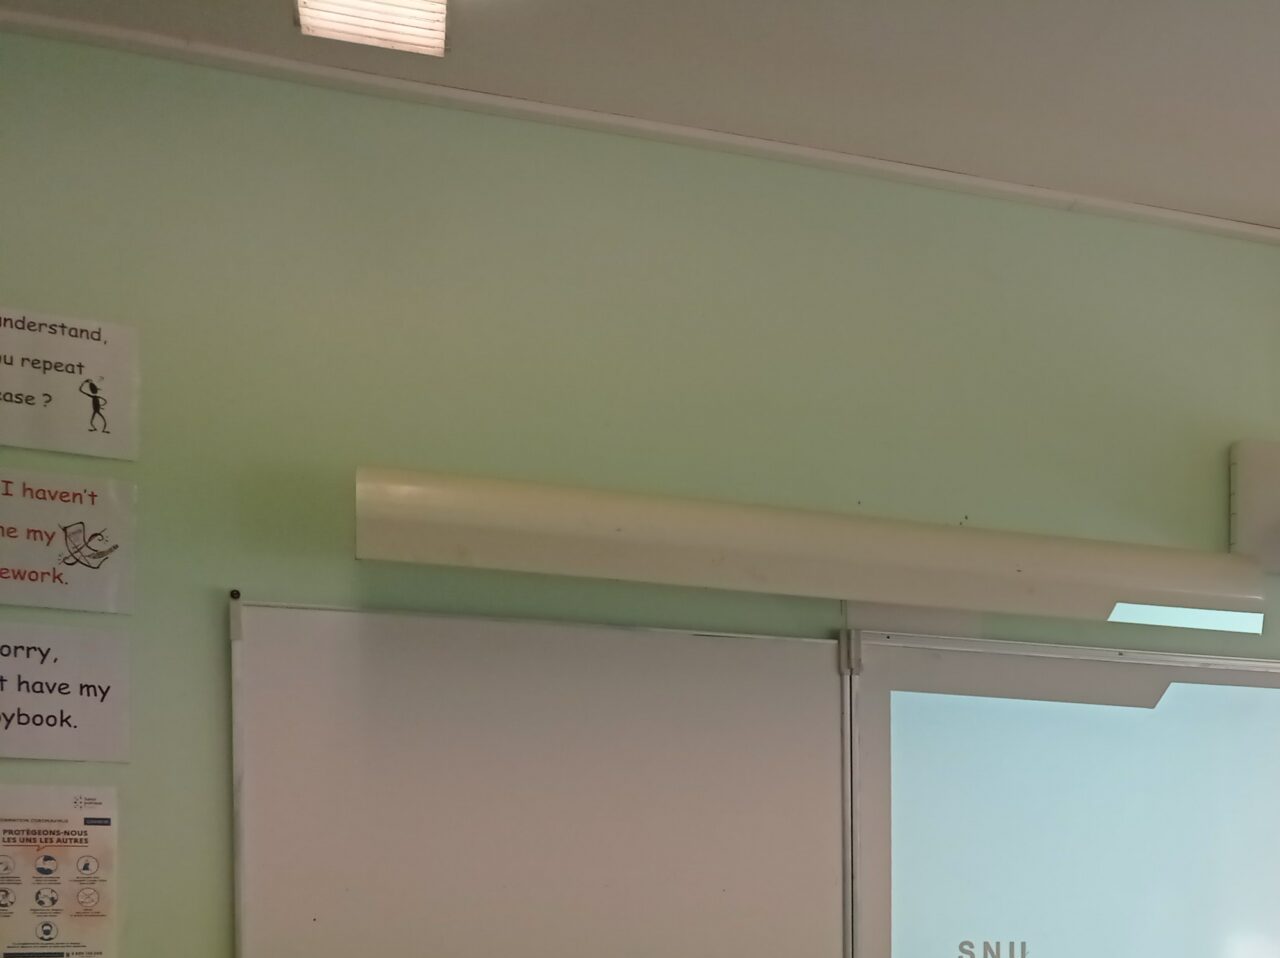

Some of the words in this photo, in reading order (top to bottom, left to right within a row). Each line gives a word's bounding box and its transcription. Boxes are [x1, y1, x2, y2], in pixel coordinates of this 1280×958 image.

[0, 316, 107, 345] nderstand,
[21, 357, 85, 375] repeat
[0, 392, 36, 406] ase
[1, 480, 14, 497] I
[22, 482, 98, 506] haven't
[26, 527, 56, 547] my
[17, 674, 71, 695] have
[79, 682, 111, 703] my
[0, 707, 78, 730] ybook.
